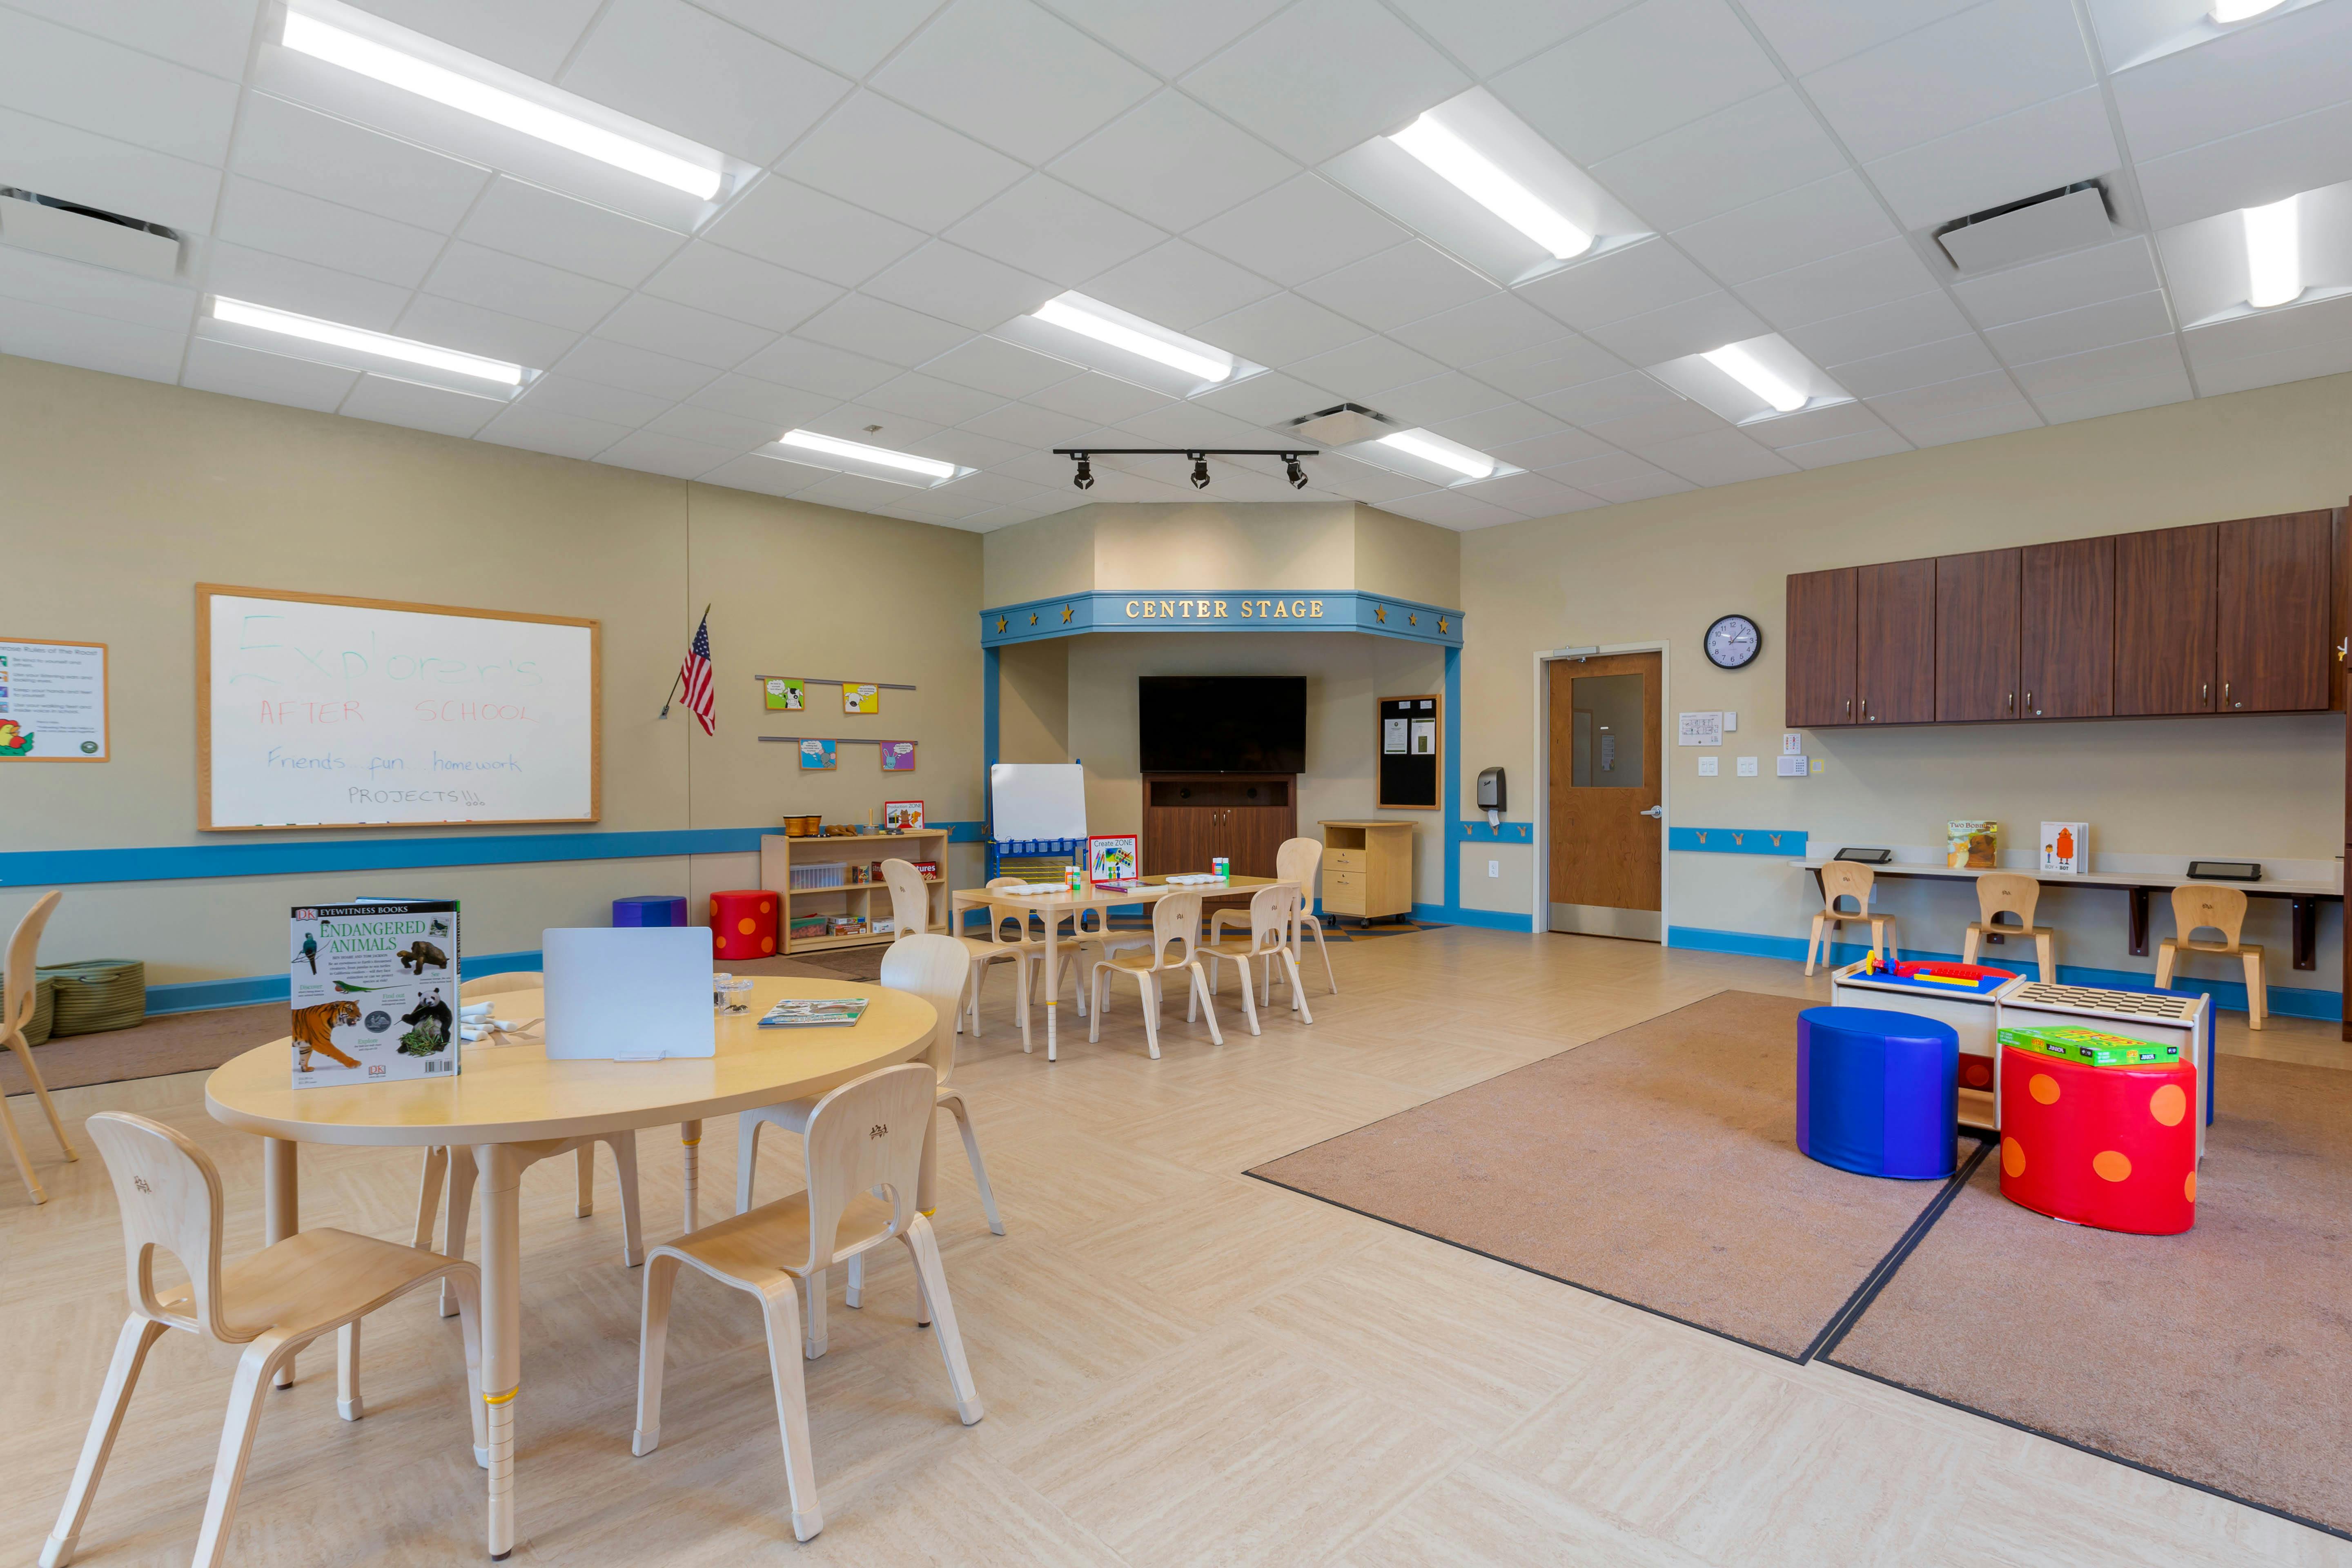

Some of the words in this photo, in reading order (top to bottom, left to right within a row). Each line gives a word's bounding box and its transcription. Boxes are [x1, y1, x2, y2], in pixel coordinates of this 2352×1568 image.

[1126, 600, 1228, 618] CENTER
[1241, 600, 1324, 618] STAGE
[261, 700, 364, 724] AFTER
[415, 700, 540, 723] SCHOOL
[349, 787, 486, 806] PROJECTS!!!
[297, 909, 316, 920] DK
[320, 907, 376, 916] EYEWITNESS
[320, 920, 425, 938] ENDANGERED
[330, 937, 397, 953] ANIMALS
[370, 1065, 385, 1074] DK
